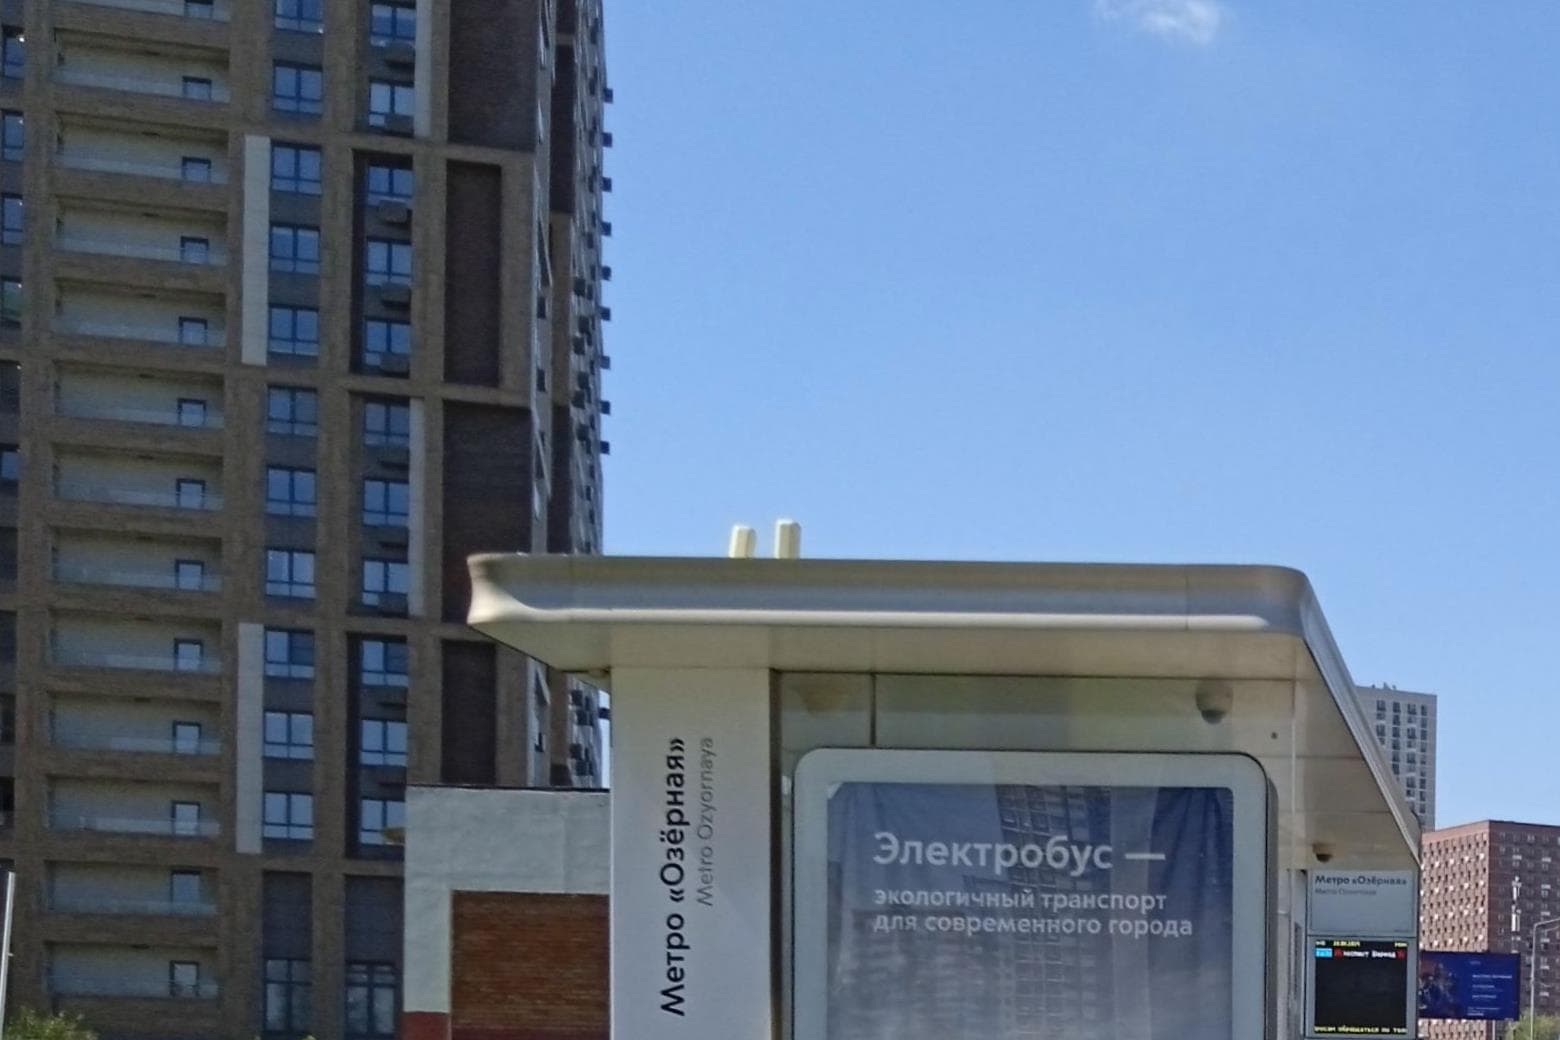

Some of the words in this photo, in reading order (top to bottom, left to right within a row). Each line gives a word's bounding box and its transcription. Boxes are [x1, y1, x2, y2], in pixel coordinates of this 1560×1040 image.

[697, 737, 716, 840] Ozyornaya
[659, 738, 690, 903] «Озёрная»
[697, 846, 713, 907] Metro
[872, 832, 1113, 877] Электробус
[1315, 875, 1350, 886] Метро
[873, 914, 918, 934] для
[924, 914, 1101, 937] современного
[1108, 917, 1193, 937] города
[874, 888, 1035, 910] экологичный
[1040, 892, 1167, 913] транспорт
[660, 913, 690, 1017] Метро
